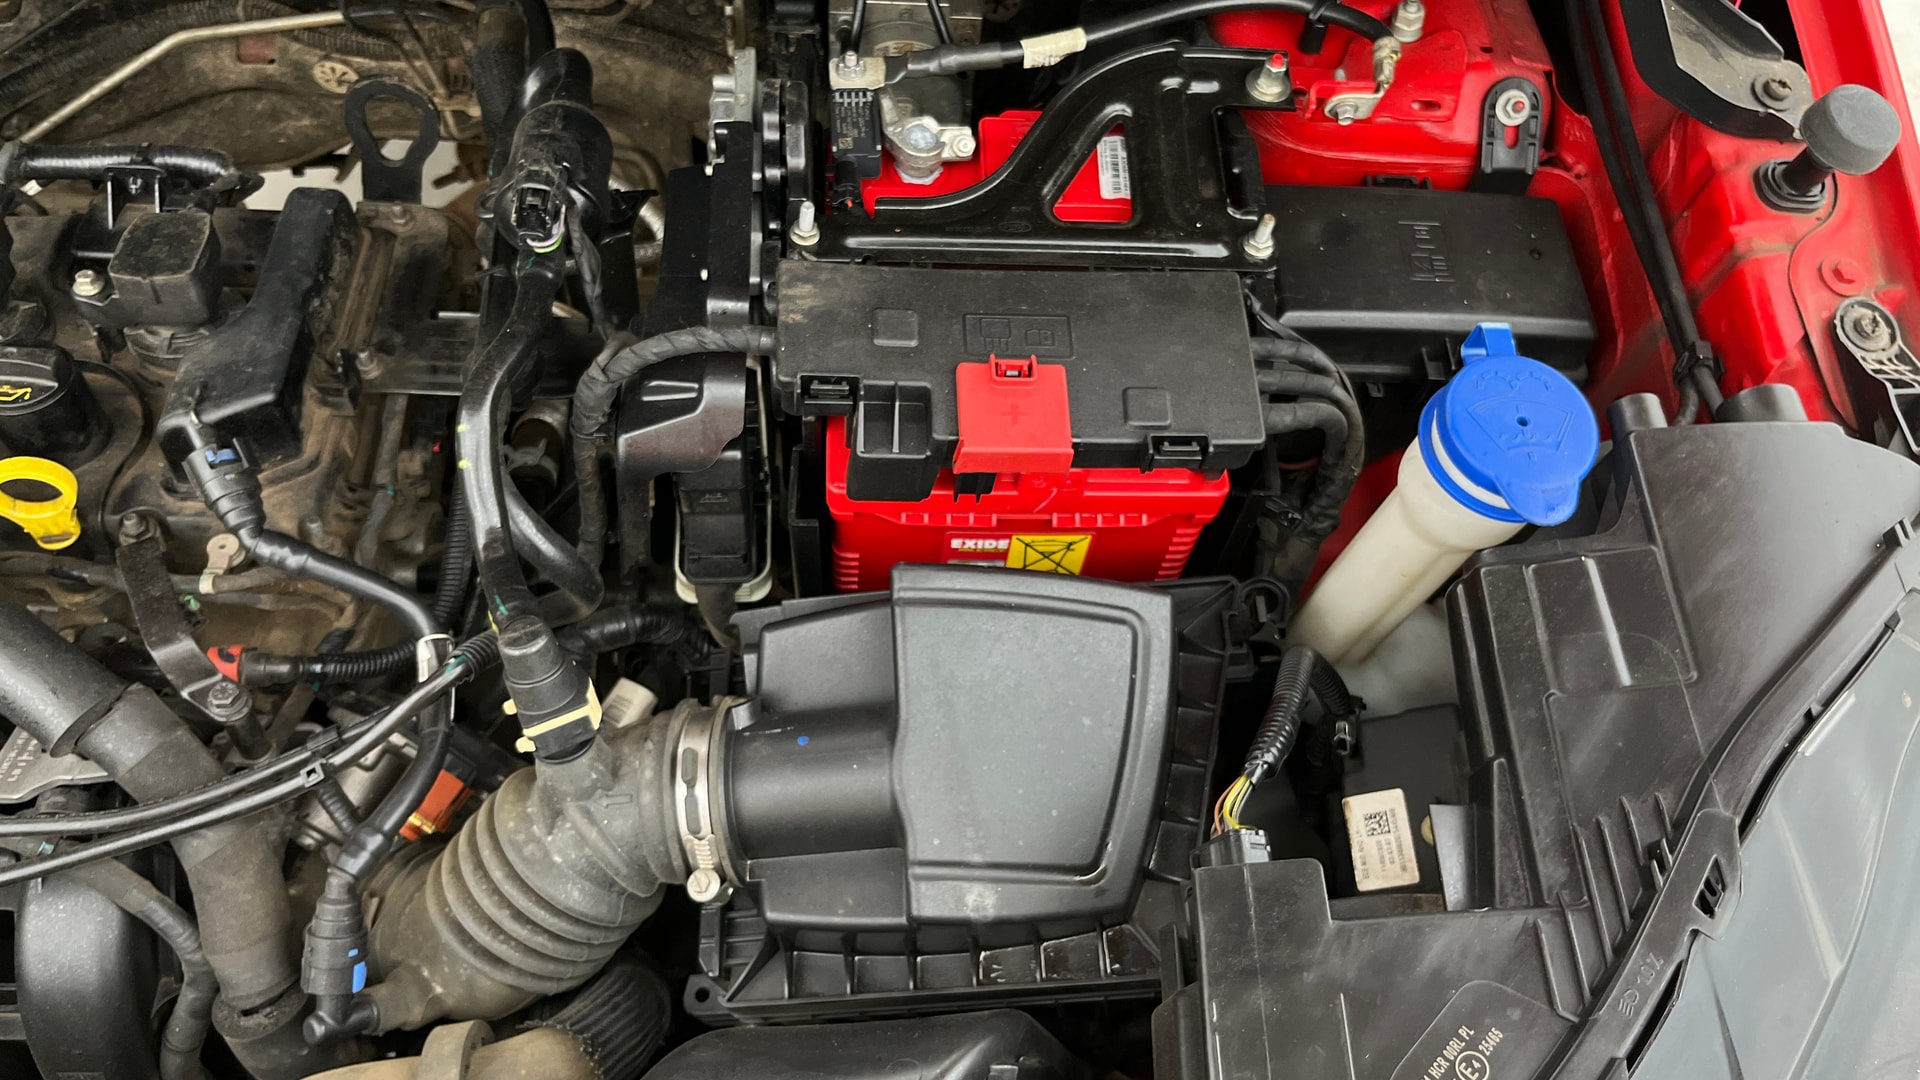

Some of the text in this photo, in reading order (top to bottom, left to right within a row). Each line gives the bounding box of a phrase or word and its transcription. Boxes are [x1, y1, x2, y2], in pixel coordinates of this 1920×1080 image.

[951, 538, 1010, 549] EXIDE
[1428, 1057, 1450, 1080] HCR
[1458, 1025, 1475, 1040] PL
[1478, 1027, 1504, 1056] 25465
